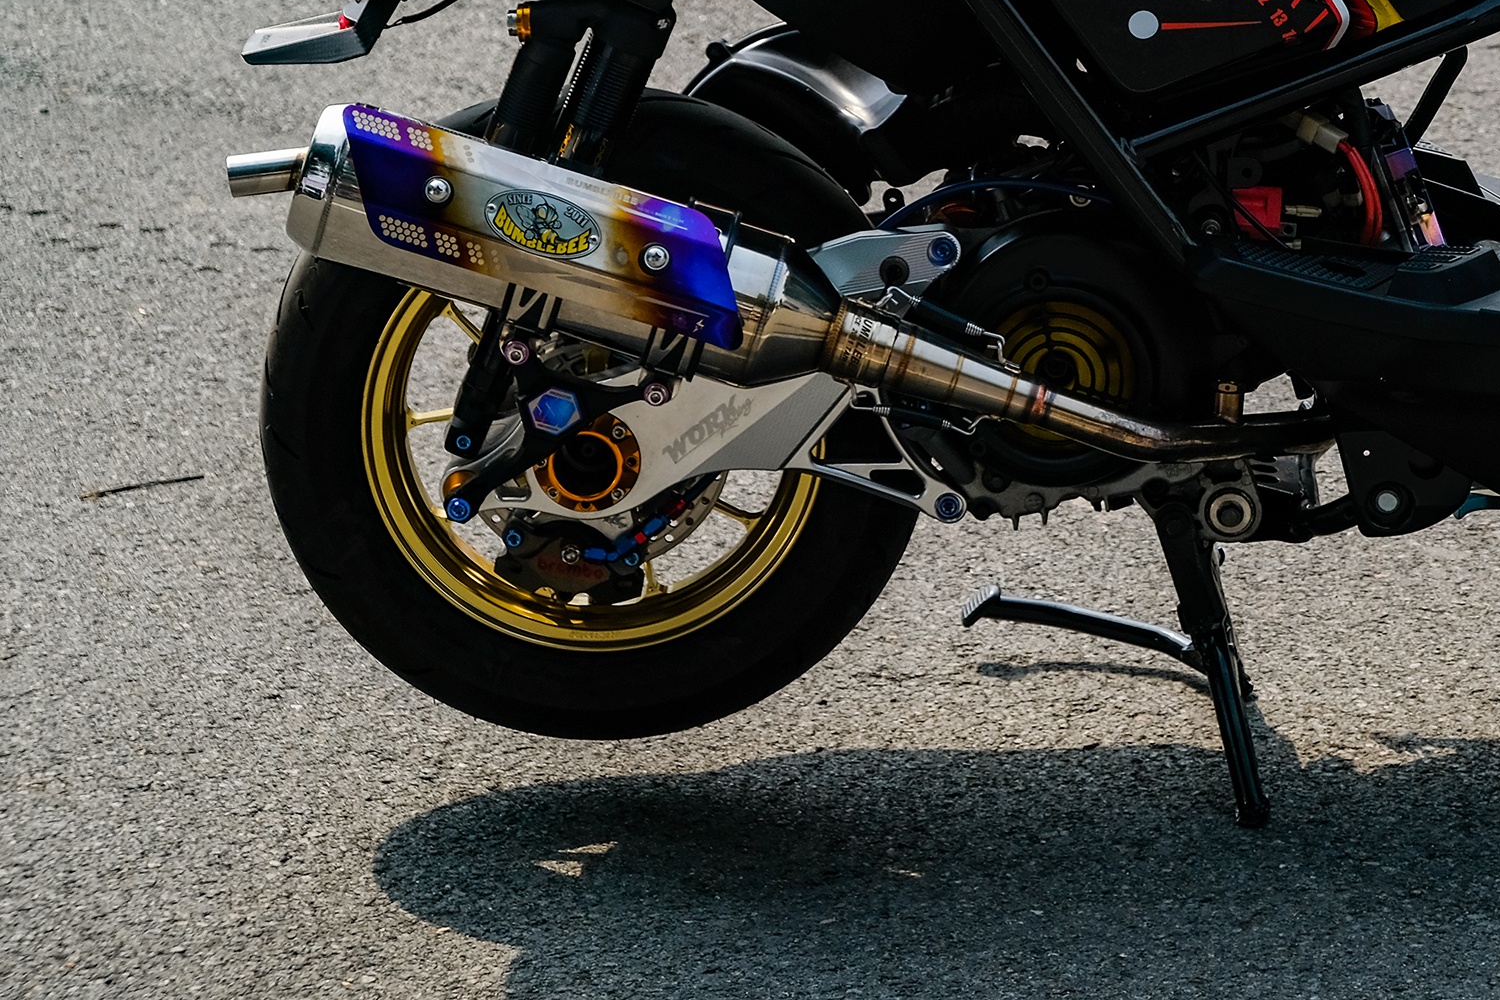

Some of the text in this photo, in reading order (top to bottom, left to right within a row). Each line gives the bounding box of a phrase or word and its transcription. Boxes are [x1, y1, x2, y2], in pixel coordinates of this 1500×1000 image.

[1269, 8, 1288, 27] 13
[493, 202, 593, 256] BUMBLEBEE
[506, 192, 592, 229] SINCE 2011
[661, 393, 736, 464] WORK
